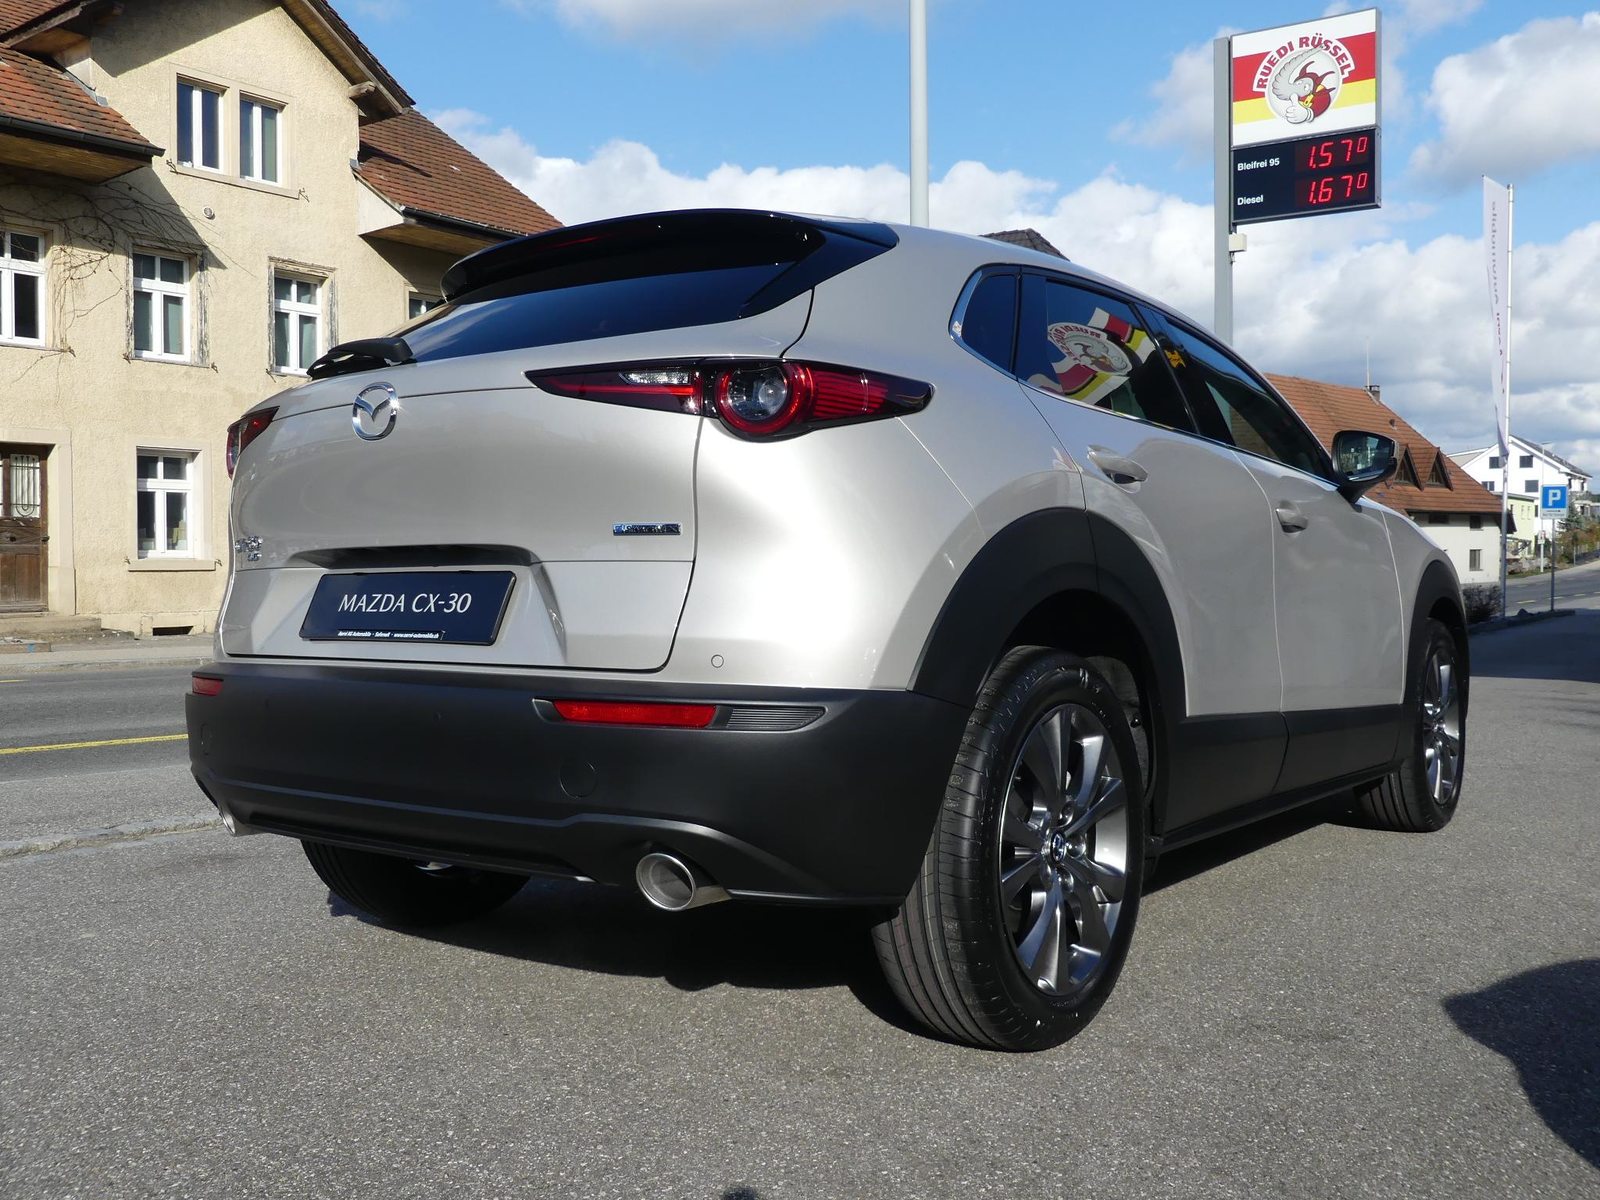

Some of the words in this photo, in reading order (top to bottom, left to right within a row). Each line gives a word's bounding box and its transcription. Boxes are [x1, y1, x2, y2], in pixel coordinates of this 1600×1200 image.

[1256, 41, 1294, 88] RUEDI
[1299, 33, 1351, 75] RÜSSEL
[1237, 159, 1268, 171] Bleifrei
[1269, 157, 1280, 167] 95
[1237, 195, 1264, 206] Diesel
[1548, 489, 1561, 506] P
[338, 594, 405, 613] MAZDA
[411, 593, 472, 613] CX-30
